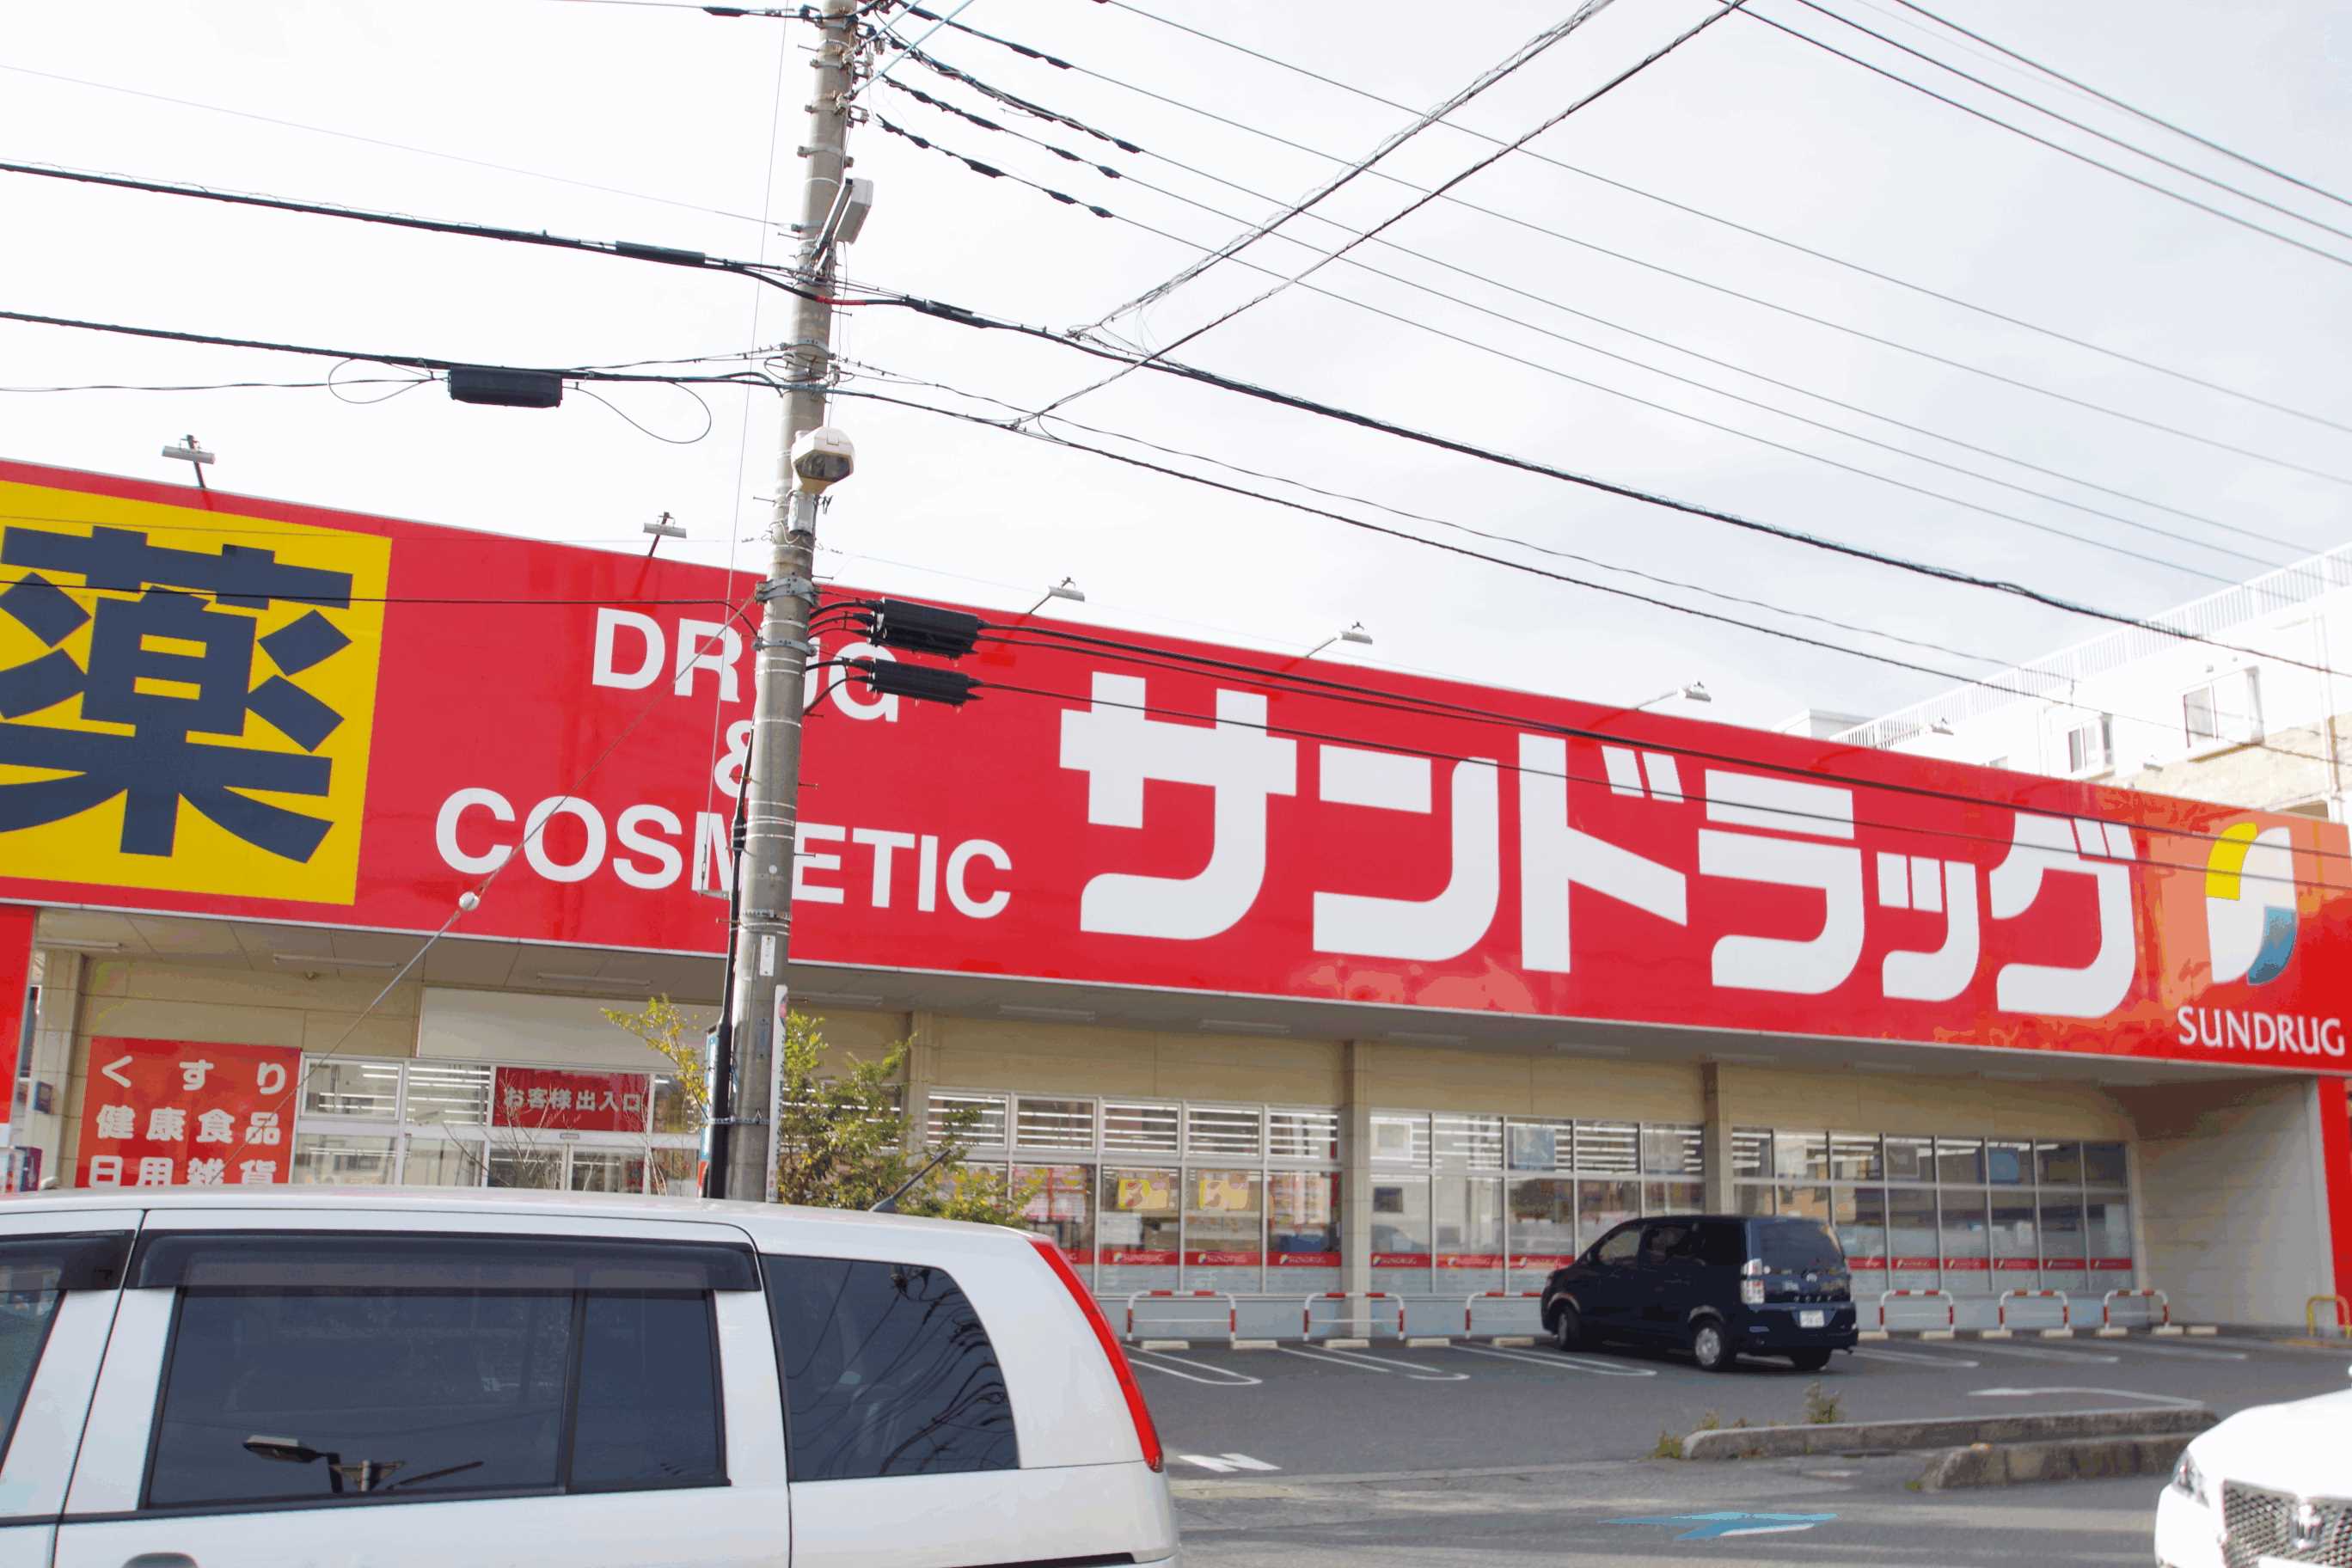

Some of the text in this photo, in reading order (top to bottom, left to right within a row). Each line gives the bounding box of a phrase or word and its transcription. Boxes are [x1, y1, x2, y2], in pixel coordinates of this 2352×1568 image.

[592, 606, 900, 723] DRG
[0, 525, 354, 864] 薬
[1059, 671, 2138, 1020] サンドラッグ
[2177, 1005, 2346, 1057] SUNDRUG
[101, 1055, 287, 1095] くすり
[504, 1086, 641, 1113] お客様出入口
[95, 1104, 282, 1145] 健康食品
[89, 1155, 277, 1186] 日用雑貨
